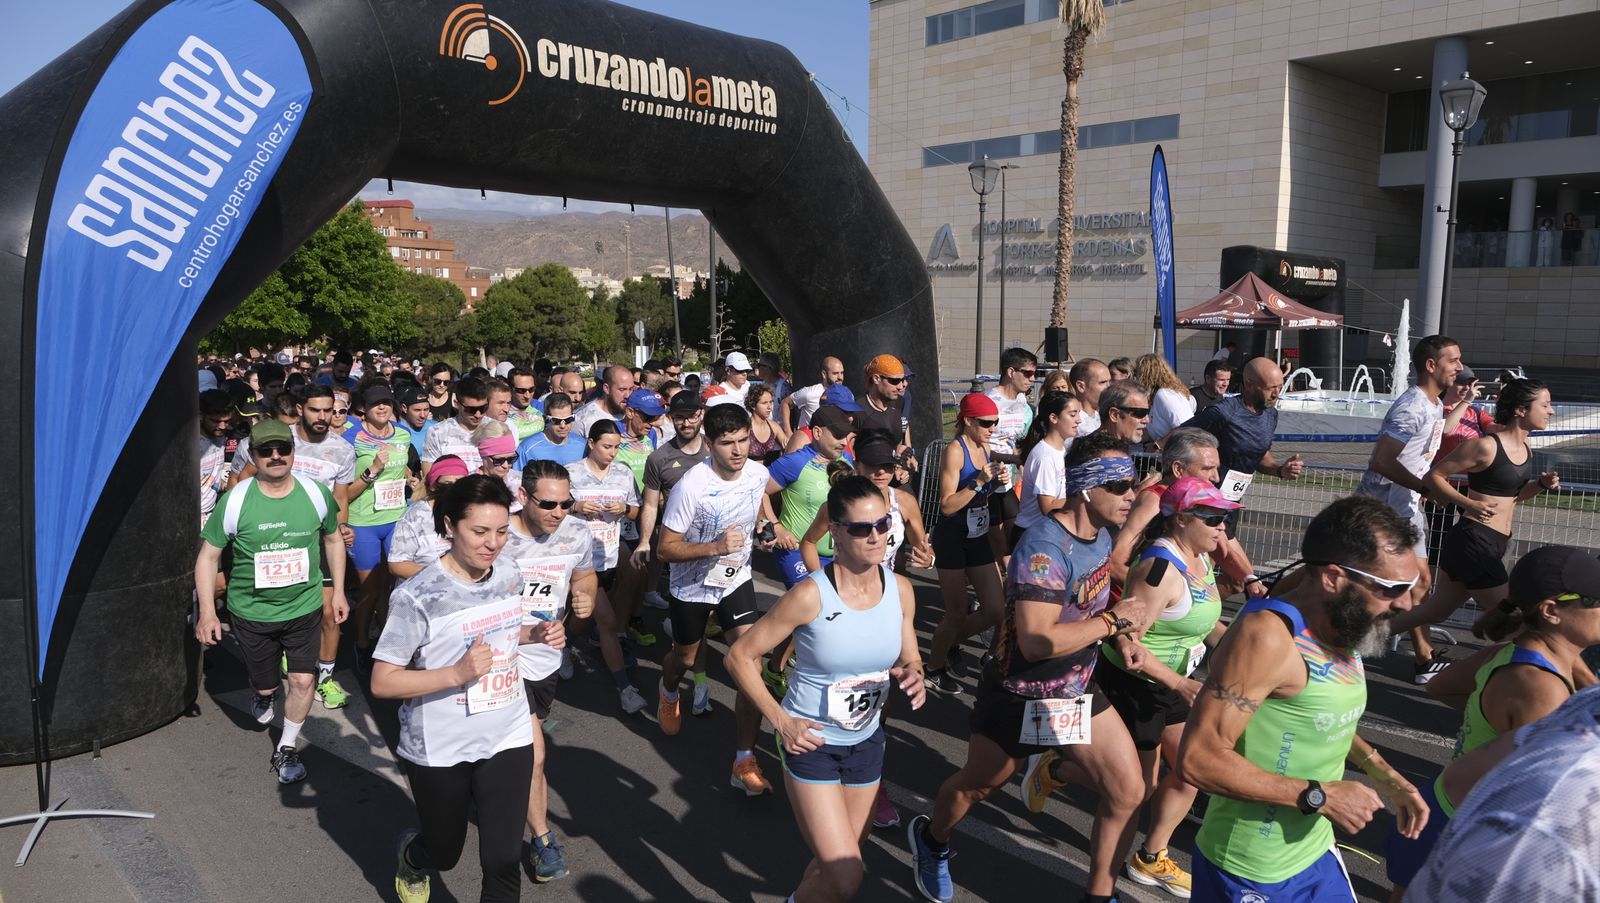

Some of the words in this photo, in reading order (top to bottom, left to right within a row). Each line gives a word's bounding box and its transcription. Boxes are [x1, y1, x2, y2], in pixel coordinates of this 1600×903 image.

[622, 97, 716, 126] cronometraje
[718, 112, 777, 135] deportivo
[178, 101, 303, 289] centrohogarsanchez.es
[994, 266, 1036, 276] HSPITAL
[381, 490, 403, 500] 1096
[1233, 482, 1245, 492] 64
[262, 561, 302, 576] 1211
[479, 666, 519, 693] 1064
[844, 690, 882, 713] 157
[1031, 711, 1082, 730] 1192
